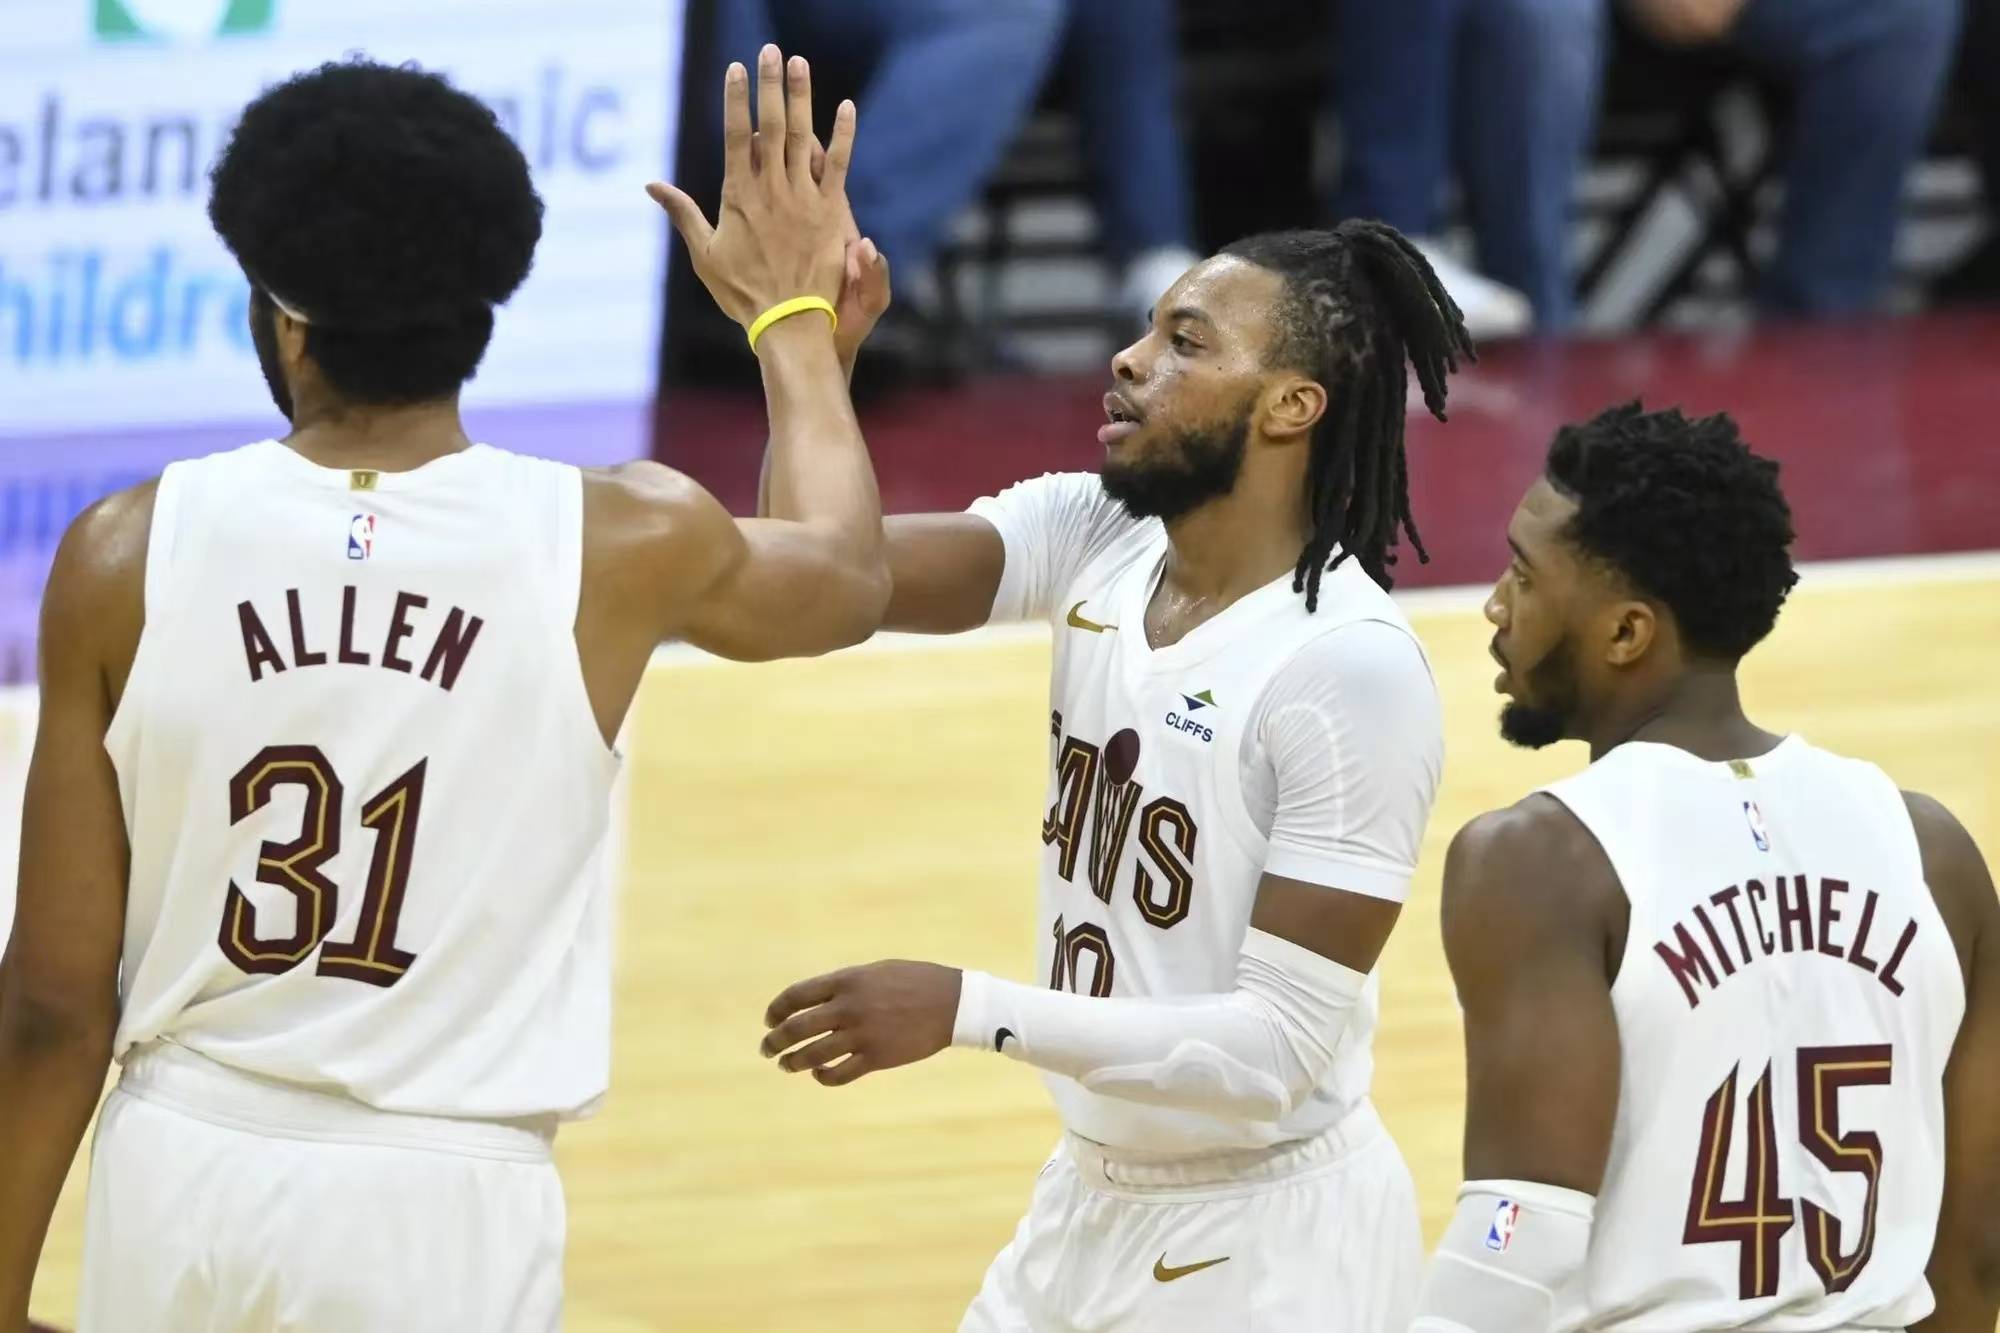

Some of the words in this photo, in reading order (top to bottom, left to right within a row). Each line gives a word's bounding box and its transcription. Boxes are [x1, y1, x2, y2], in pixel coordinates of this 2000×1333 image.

[237, 585, 484, 691] ALLEN
[1165, 711, 1213, 743] CLIFFS
[217, 744, 428, 988] 31
[1653, 873, 1918, 1010] MITCHELL
[1682, 1043, 1893, 1301] 45
